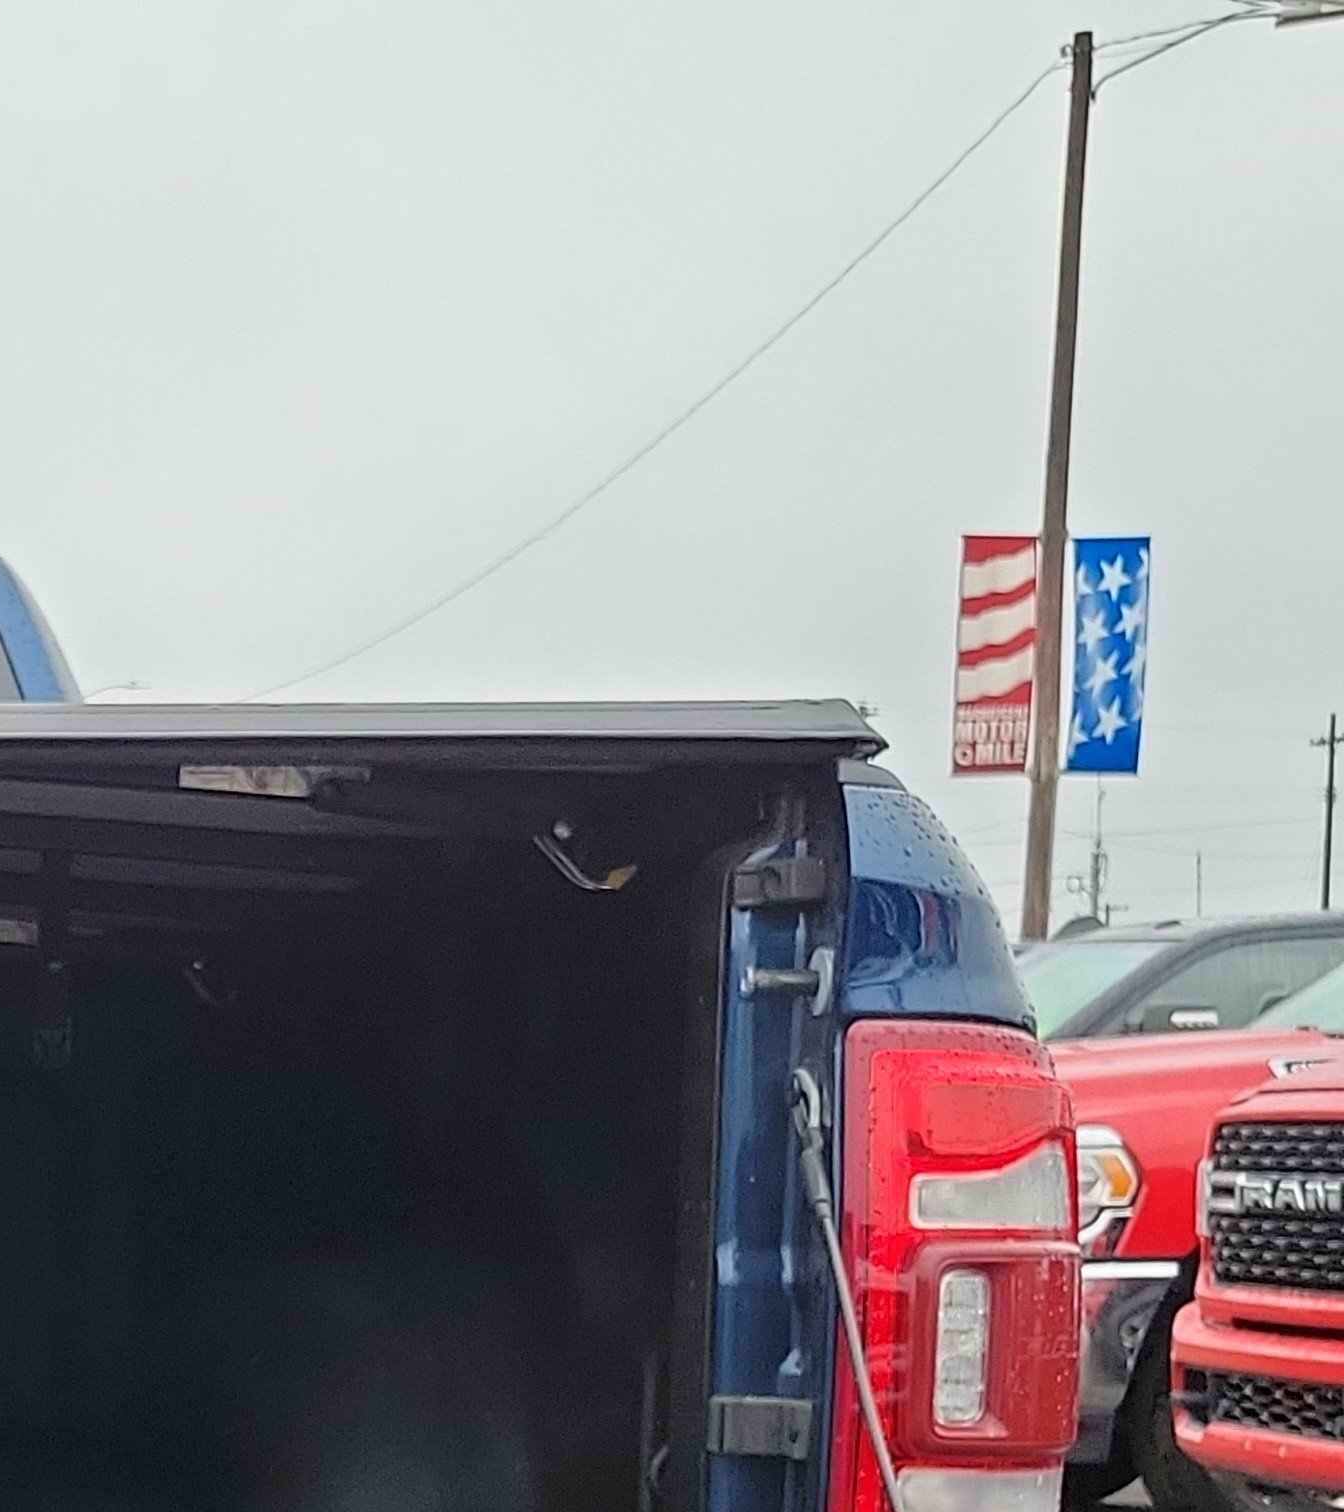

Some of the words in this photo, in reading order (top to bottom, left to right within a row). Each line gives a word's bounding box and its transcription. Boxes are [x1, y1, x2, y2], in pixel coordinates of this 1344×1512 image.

[955, 721, 1027, 743] MOTOR
[975, 743, 1024, 765] MILE
[1239, 1178, 1342, 1212] RAM
